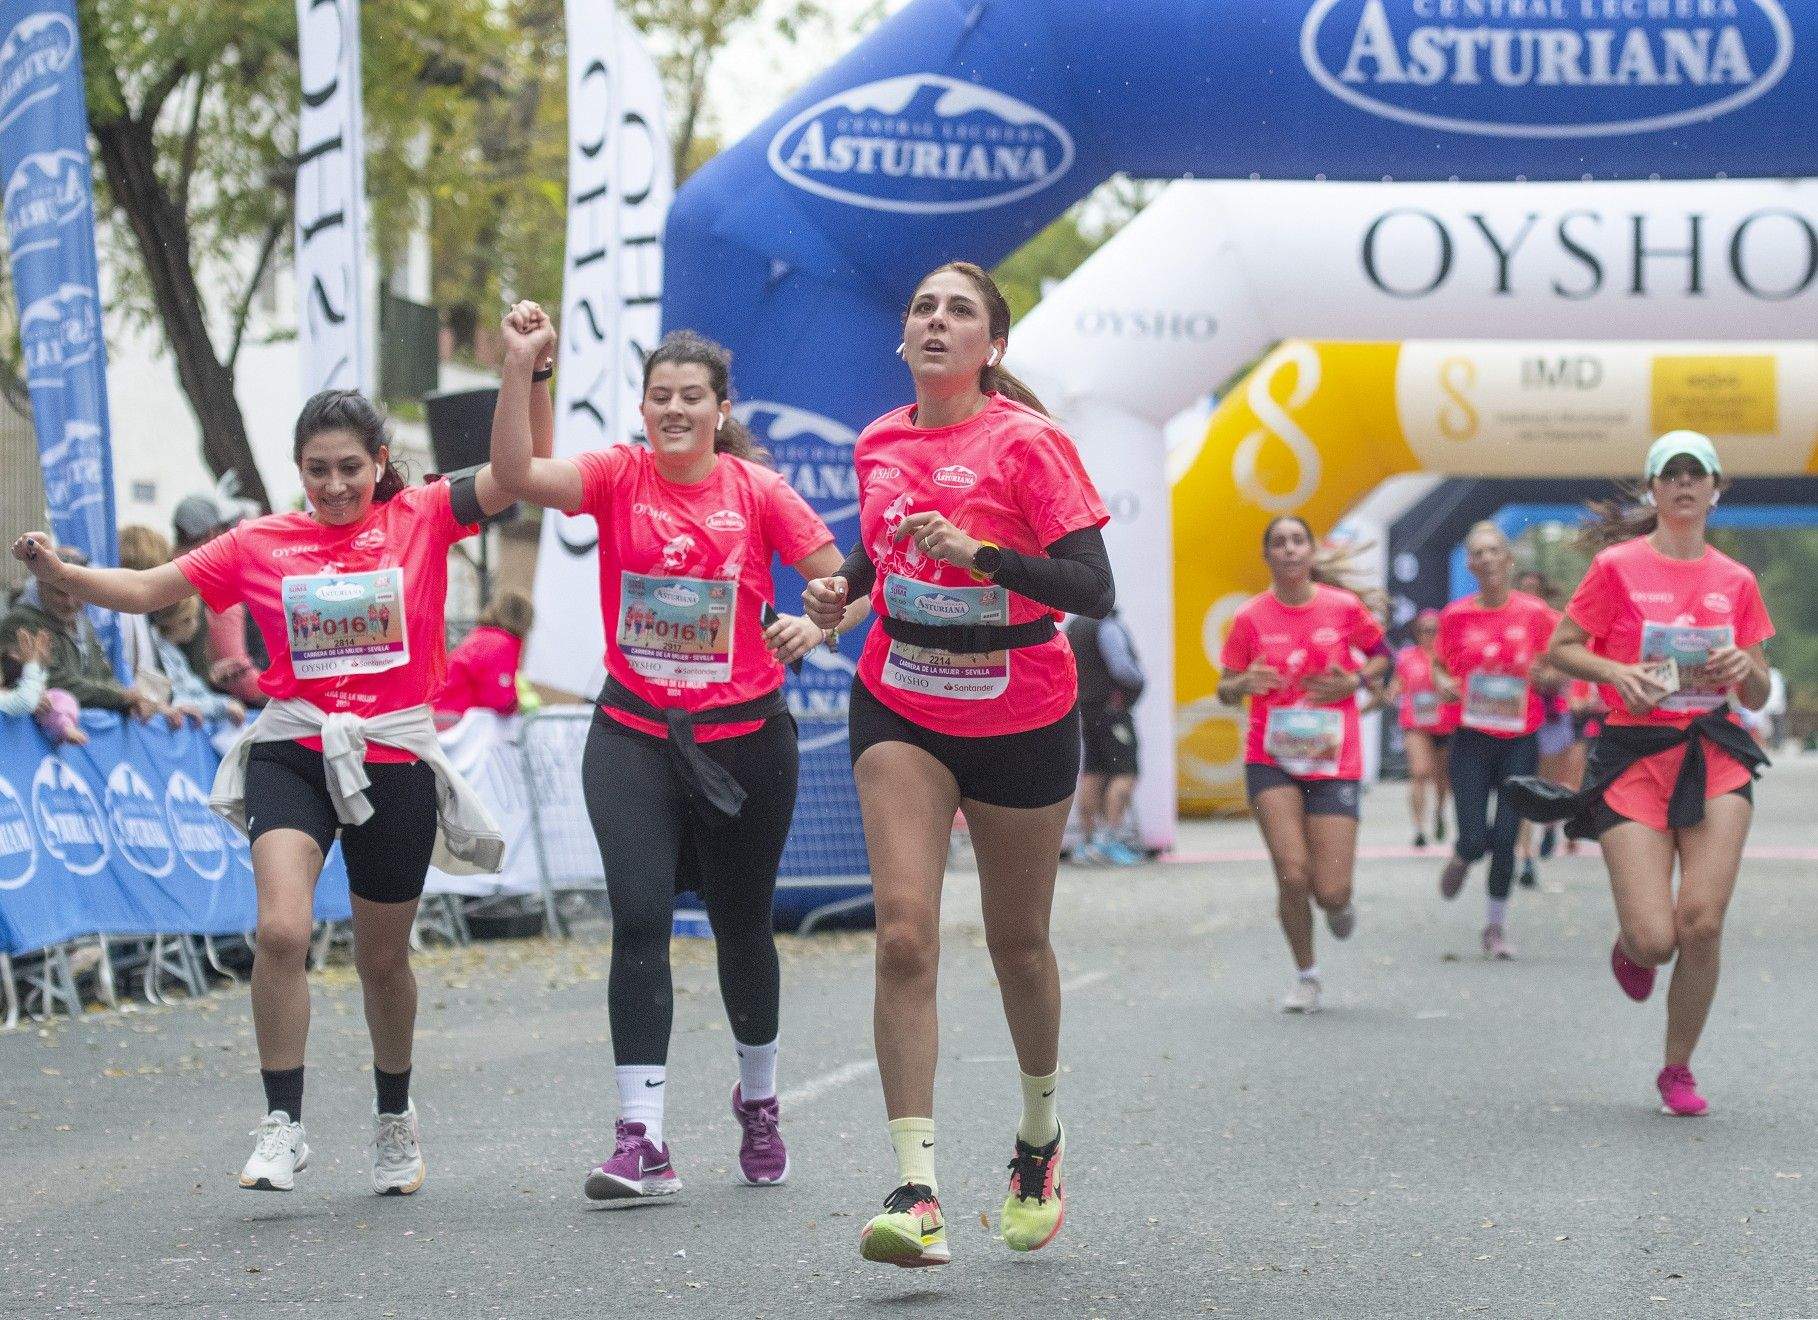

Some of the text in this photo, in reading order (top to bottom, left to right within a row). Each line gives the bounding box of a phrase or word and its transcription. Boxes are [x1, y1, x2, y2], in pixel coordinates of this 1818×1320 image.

[1337, 0, 1755, 86] ASTURIANA
[786, 119, 1051, 181] ASTURIANA
[1360, 206, 1818, 300] OYSHO
[1074, 308, 1219, 341] OYSHO
[1519, 355, 1602, 390] IMD
[919, 598, 966, 614] ASTURIANA
[323, 616, 366, 635] 016
[655, 620, 696, 641] 016
[899, 659, 920, 671] CARRERA
[965, 668, 990, 676] SEVILLA
[929, 655, 951, 666] 2214
[894, 671, 929, 688] OYSHO
[954, 684, 994, 692] Santander
